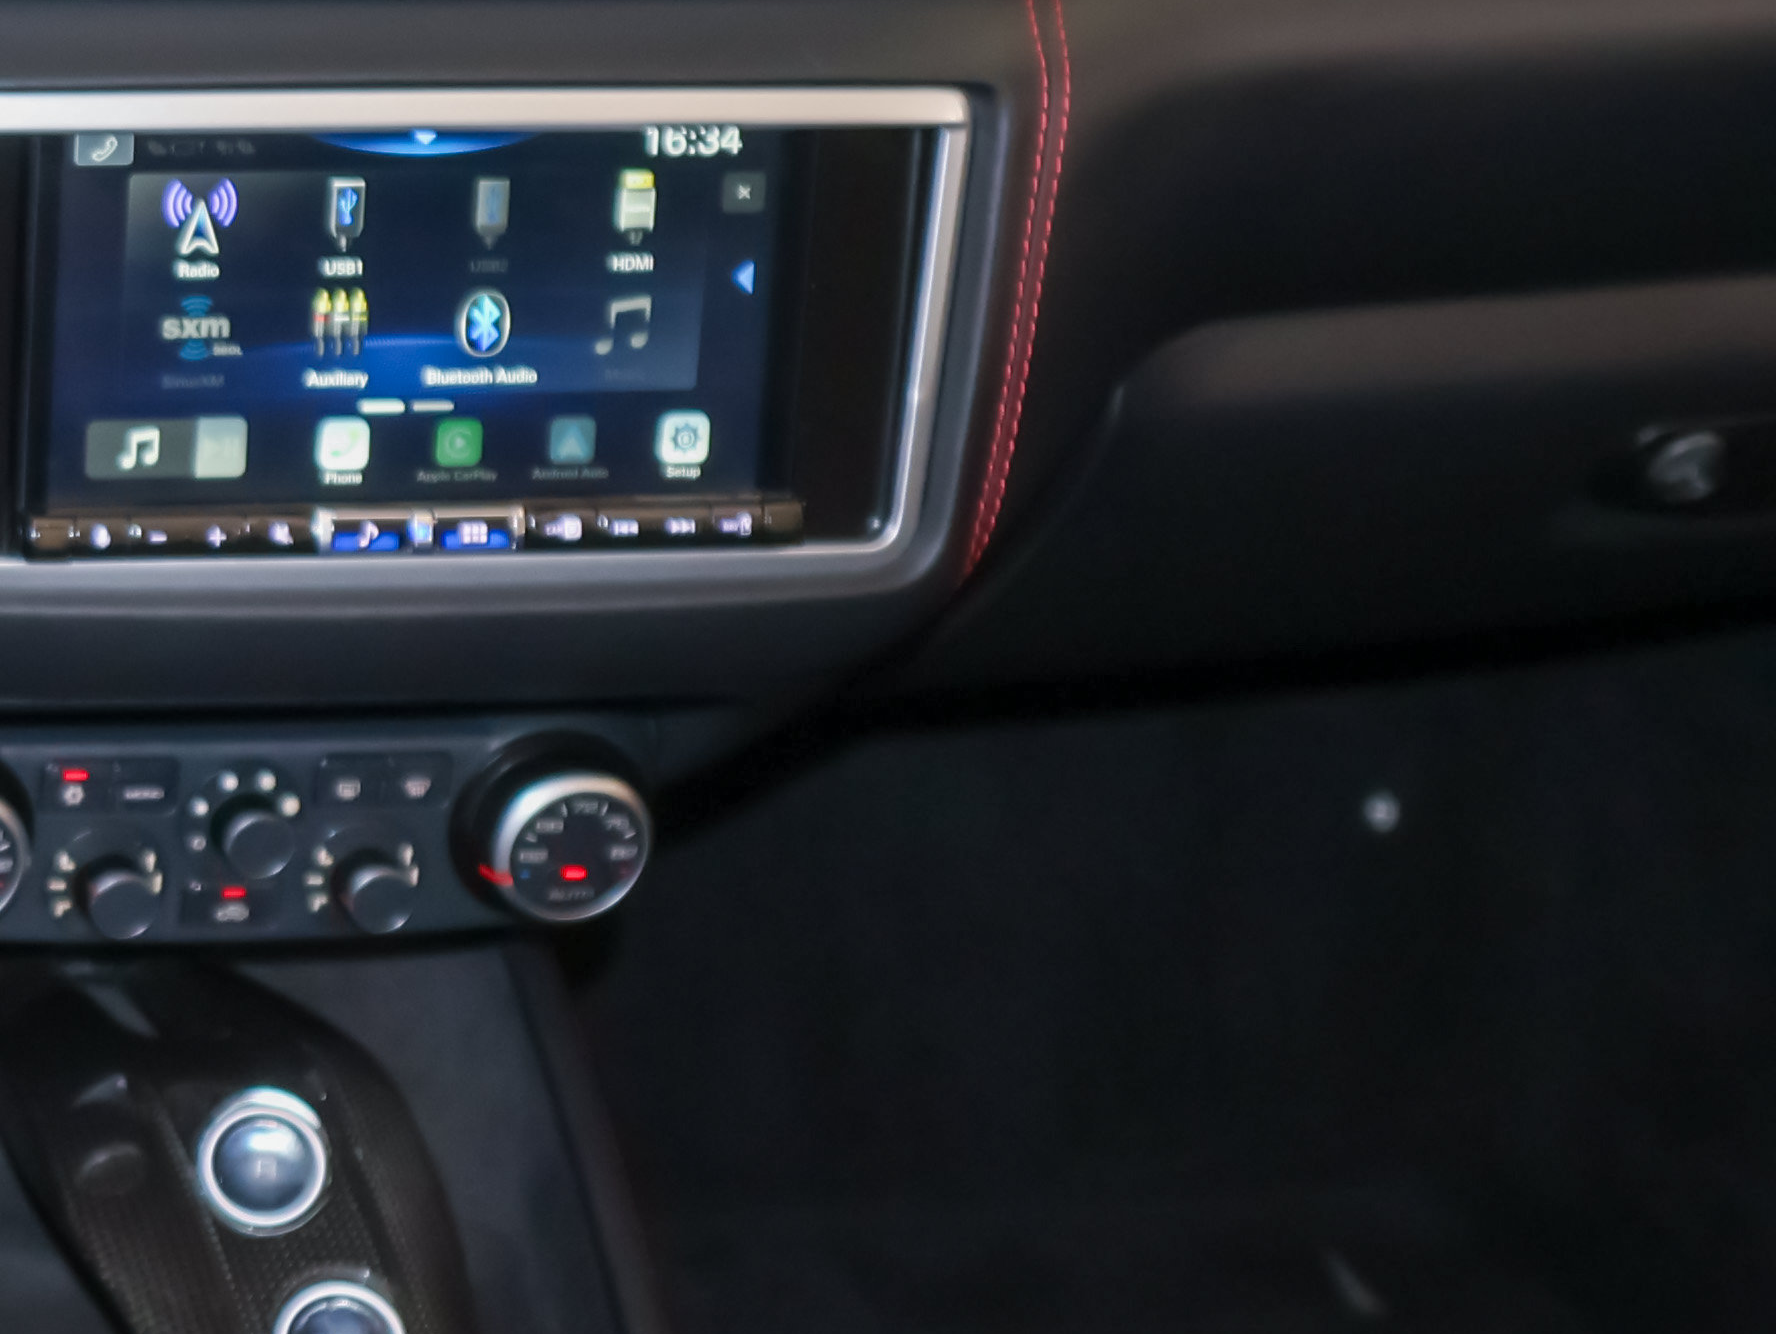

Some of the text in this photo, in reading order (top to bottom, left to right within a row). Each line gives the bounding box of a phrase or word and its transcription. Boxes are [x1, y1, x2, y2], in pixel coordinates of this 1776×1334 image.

[644, 124, 744, 157] 16:34
[173, 259, 221, 280] Radio
[319, 257, 364, 278] USB1
[606, 252, 655, 274] HDMI
[160, 314, 232, 341] sxm
[302, 367, 370, 389] Auxiliary
[420, 365, 539, 388] Bluetooth Audio
[321, 471, 363, 485] Phone
[663, 464, 702, 480] Setup
